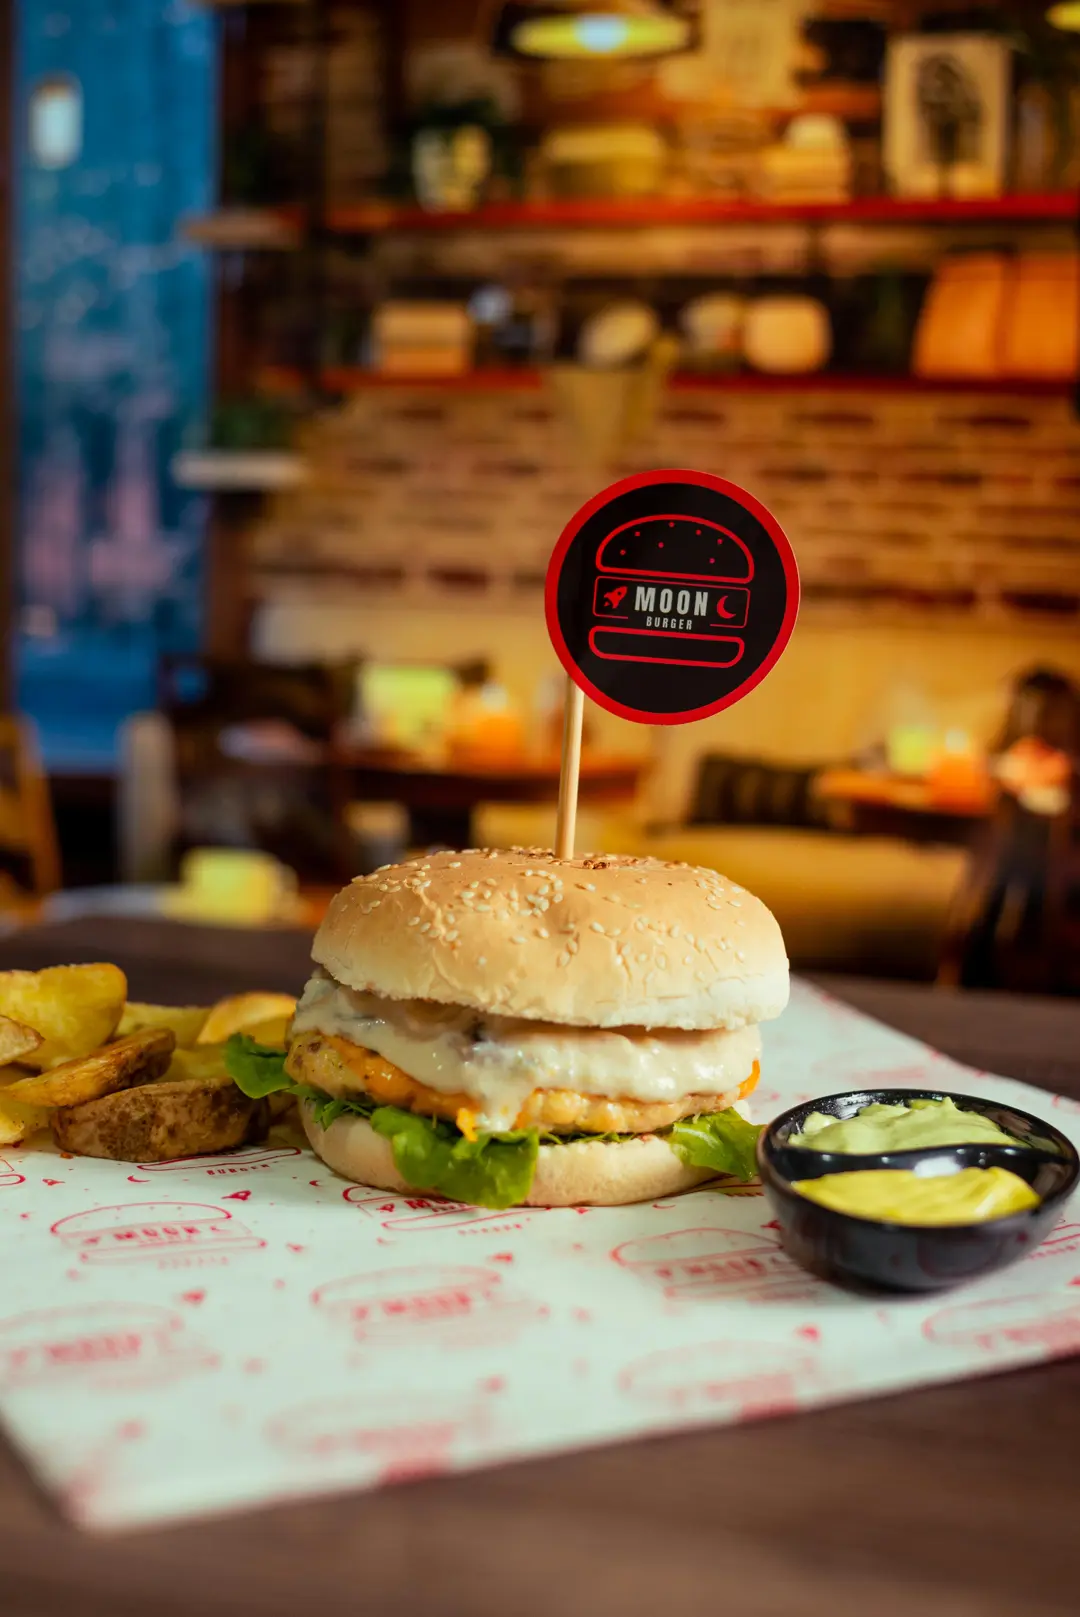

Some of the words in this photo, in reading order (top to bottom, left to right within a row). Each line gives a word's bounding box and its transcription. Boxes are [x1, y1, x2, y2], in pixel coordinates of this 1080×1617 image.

[634, 586, 709, 616] MOON
[645, 615, 693, 630] BURGER
[206, 1163, 270, 1176] BURGER
